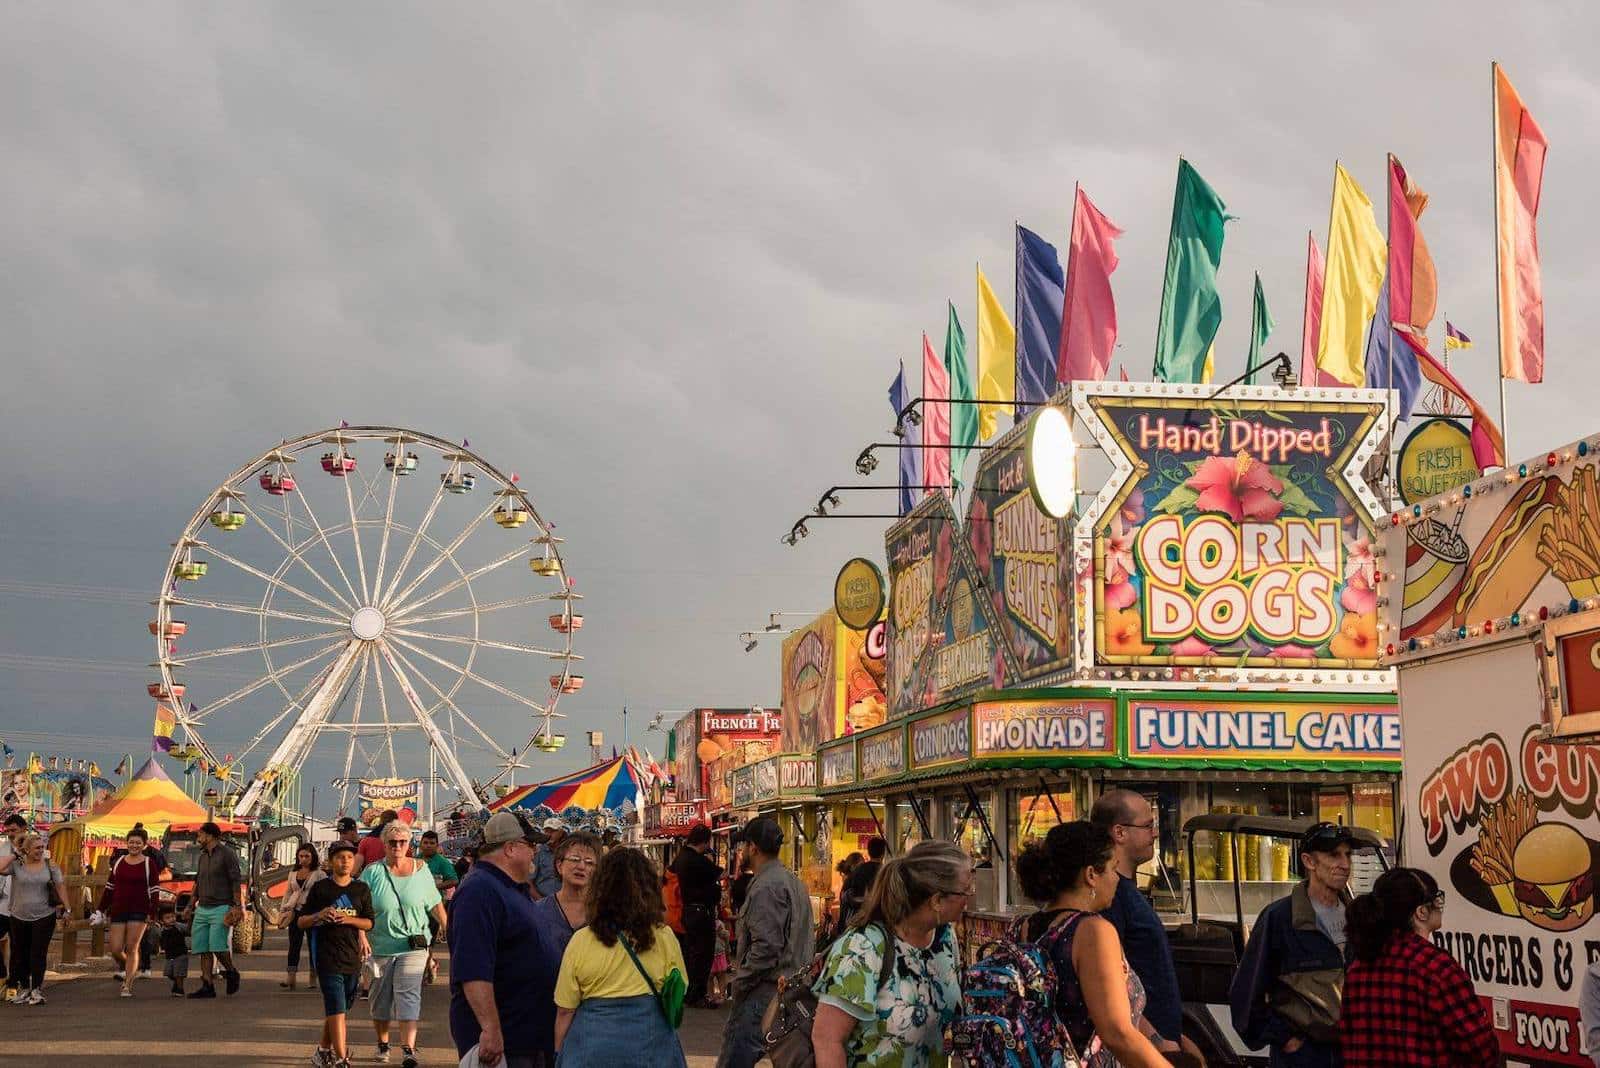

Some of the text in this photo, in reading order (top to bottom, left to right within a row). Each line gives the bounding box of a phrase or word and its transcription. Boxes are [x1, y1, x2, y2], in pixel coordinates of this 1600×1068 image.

[1139, 414, 1331, 462] Hand Dipped
[1417, 447, 1462, 471] FRESH
[1139, 518, 1339, 586] CORN
[1007, 556, 1056, 642] CAKES
[1150, 569, 1335, 638] DOGS
[704, 712, 758, 733] FRENCH
[913, 726, 939, 762] CORN
[978, 710, 1105, 749] LEMONADE
[1137, 707, 1295, 750] FUNNEL
[363, 784, 414, 798] POPCORN!
[1421, 735, 1510, 848] TWO
[1554, 938, 1573, 991] &
[1515, 1012, 1570, 1053] FOOT
